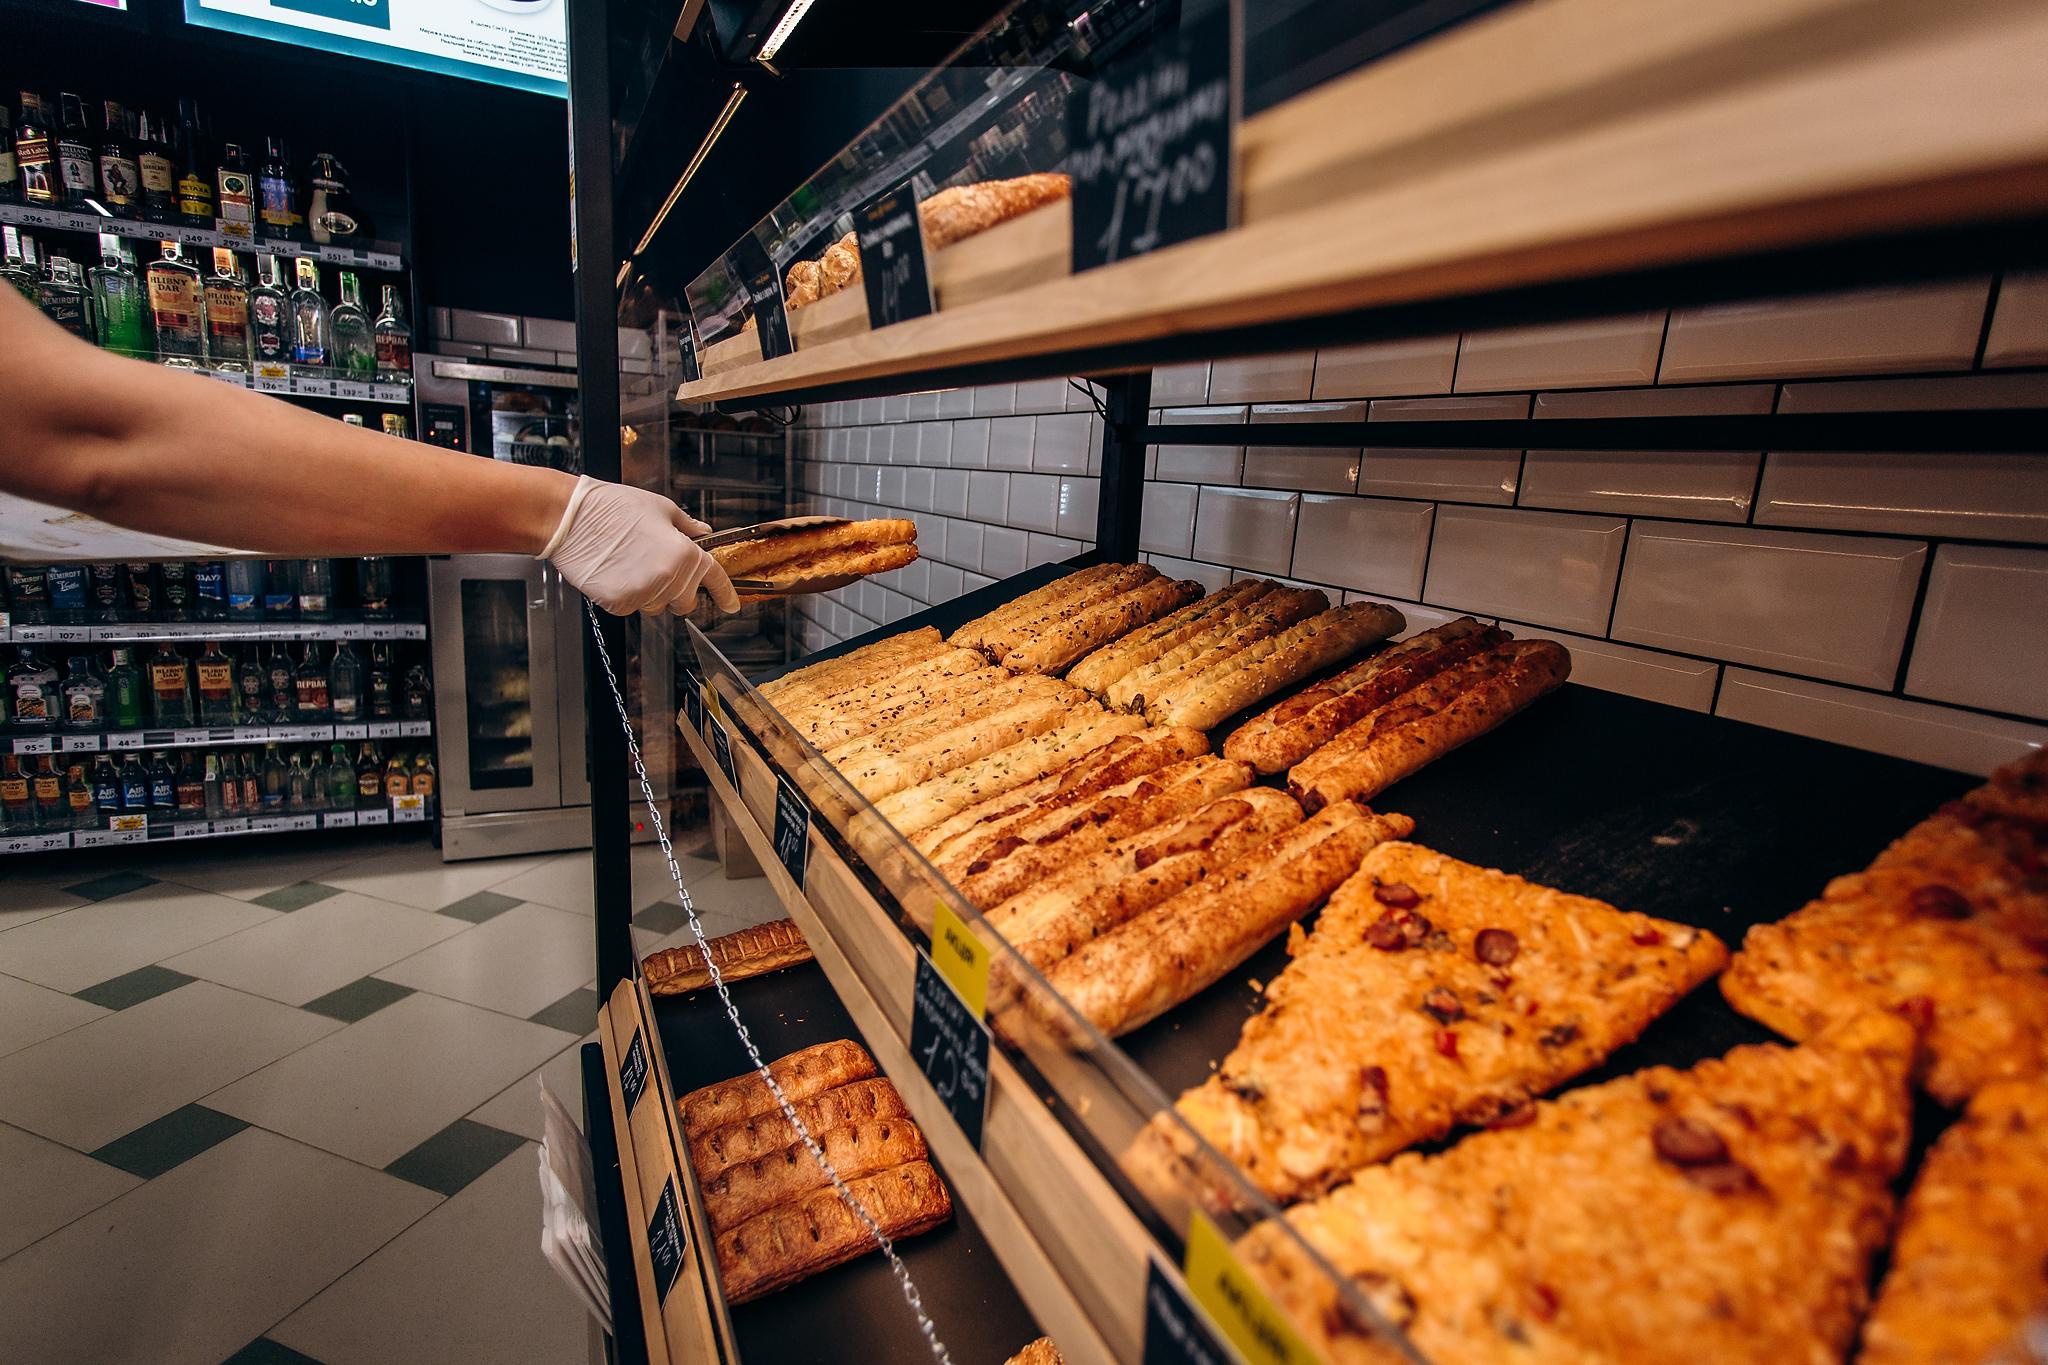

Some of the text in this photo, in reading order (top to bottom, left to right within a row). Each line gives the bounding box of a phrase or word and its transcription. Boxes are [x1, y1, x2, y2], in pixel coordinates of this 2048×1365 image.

[17, 146, 49, 158] Red Label
[23, 214, 42, 223] 396
[70, 220, 84, 228] 211
[107, 225, 126, 233] 294
[149, 230, 165, 238] 210
[185, 235, 202, 243] 349
[223, 239, 240, 248] 299
[270, 246, 287, 254] 256
[327, 253, 342, 261] 551
[150, 276, 188, 287] HLIBNY
[158, 283, 180, 293] DAR
[42, 296, 81, 305] NEMIROFF
[207, 292, 242, 302] HLIBNY
[215, 298, 236, 307] DAR
[375, 334, 409, 346] ПЕРВАК
[262, 382, 276, 390] 126
[304, 385, 317, 393] 142
[23, 632, 36, 640] 84
[59, 632, 75, 640] 107
[296, 679, 327, 689] ПЕРВАК
[118, 739, 130, 747] 44
[24, 744, 37, 752] 95
[99, 787, 116, 796] AIR
[128, 785, 144, 795] AIR
[153, 784, 170, 793] AIR
